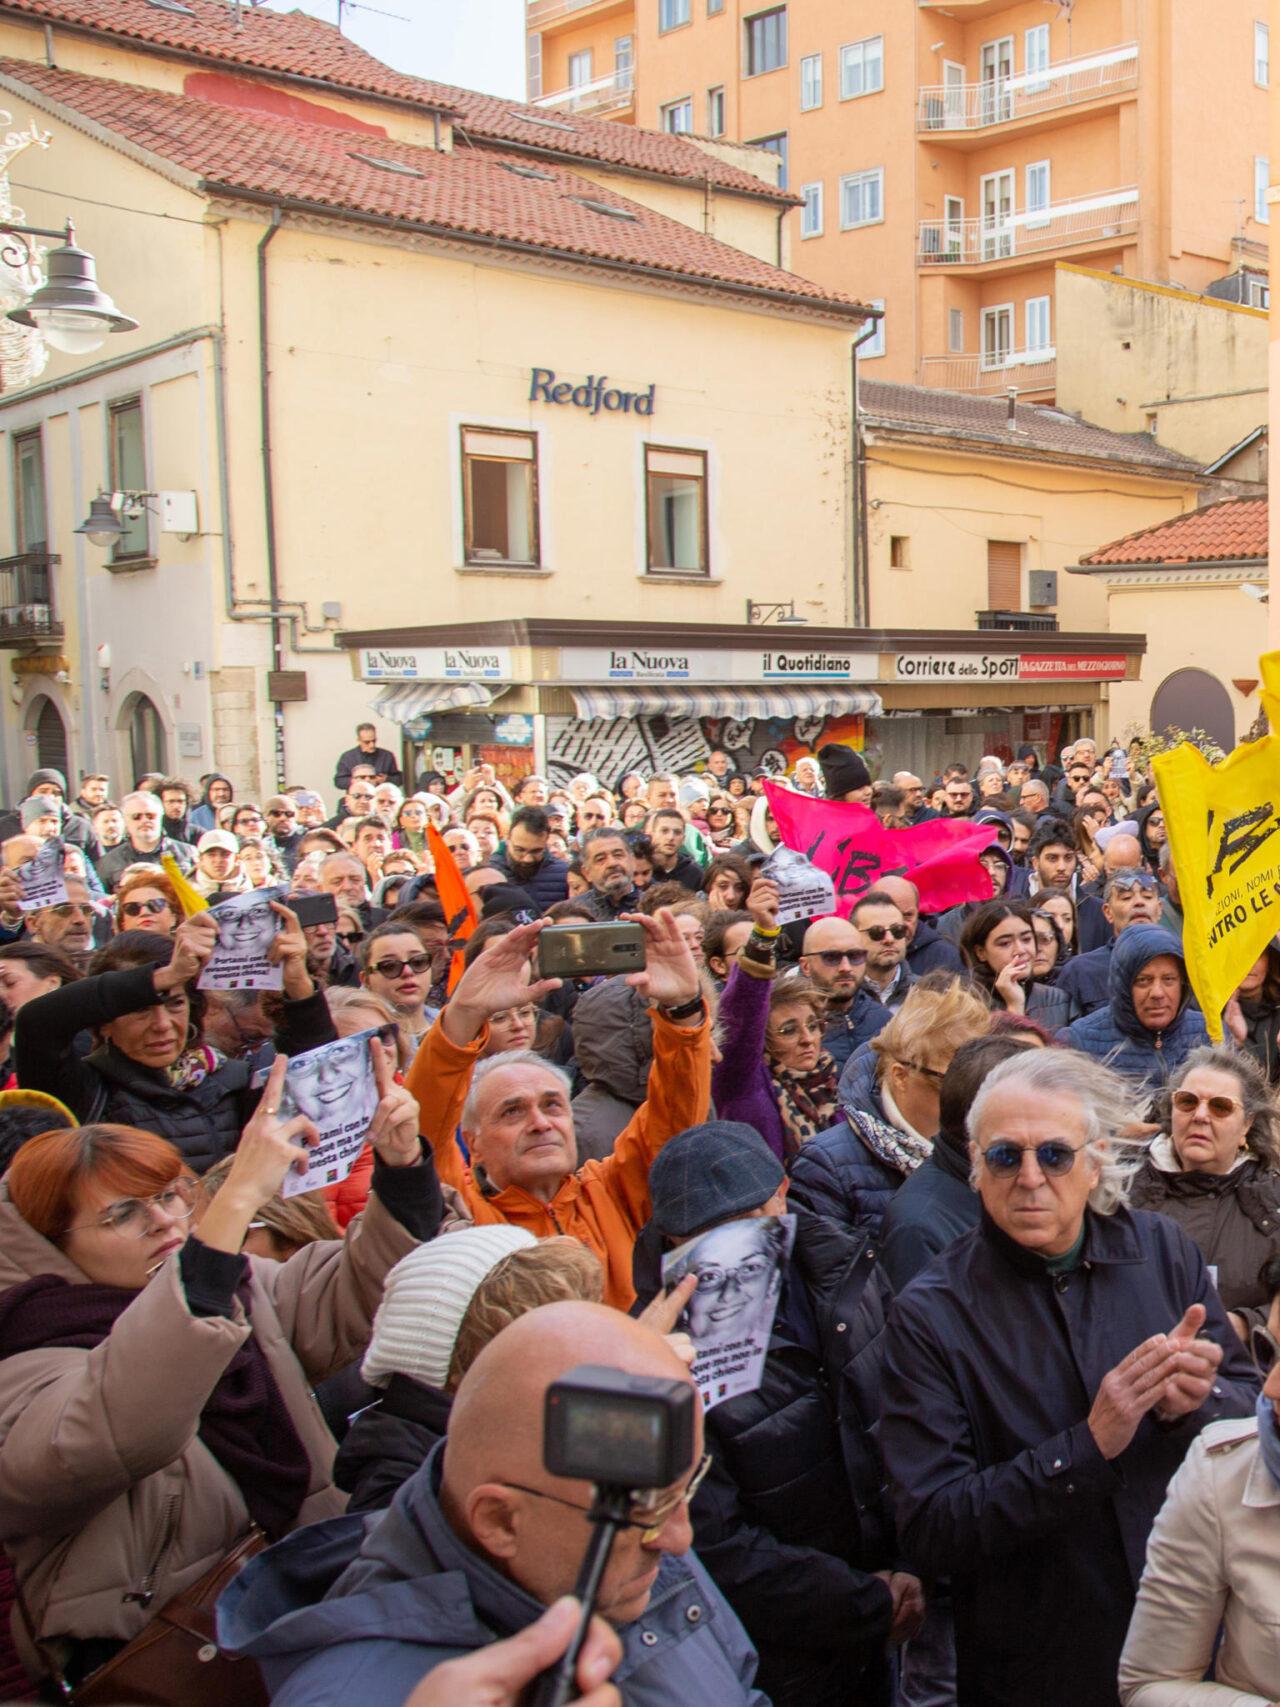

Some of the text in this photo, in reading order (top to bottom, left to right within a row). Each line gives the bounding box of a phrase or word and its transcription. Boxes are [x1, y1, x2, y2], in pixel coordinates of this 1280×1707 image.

[528, 367, 656, 416] Redford
[366, 650, 417, 668] la Nuova
[444, 650, 500, 668] la Nuova
[610, 651, 689, 669] la Nuova
[763, 653, 851, 672] il Quotidiano
[897, 656, 1019, 679] Corriere dello Sport
[1028, 661, 1067, 672] GAZZETTA
[1246, 868, 1274, 893] NOMI
[1250, 888, 1273, 914] LE
